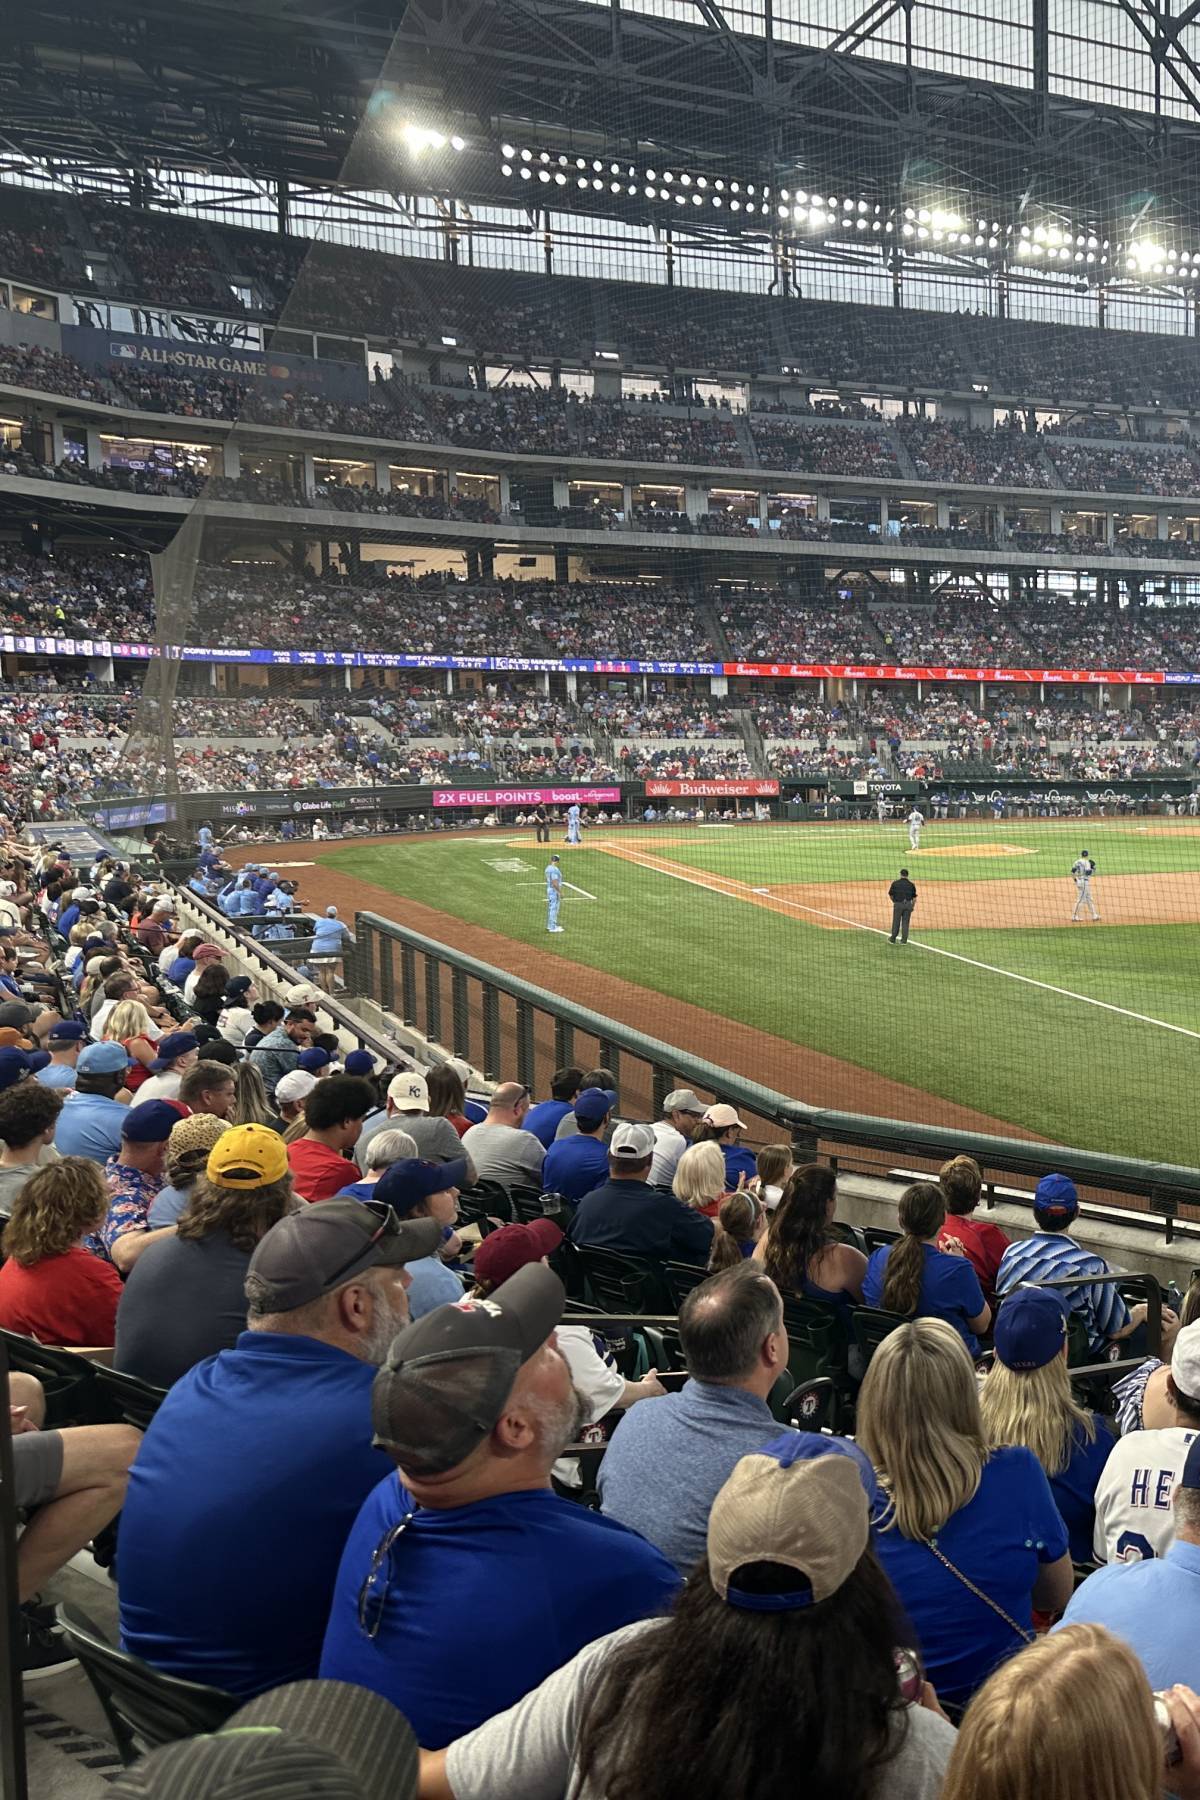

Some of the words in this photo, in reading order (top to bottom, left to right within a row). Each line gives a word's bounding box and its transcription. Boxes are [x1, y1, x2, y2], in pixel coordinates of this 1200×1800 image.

[173, 351, 217, 371] STAR
[219, 357, 267, 379] GAME
[680, 783, 749, 795] Budweiser
[439, 794, 454, 804] 2X
[459, 792, 490, 803] FUEL
[496, 791, 541, 802] POINTS
[302, 801, 319, 810] Globe
[320, 800, 331, 809] Life
[332, 799, 345, 808] Field
[409, 1085, 421, 1098] KC
